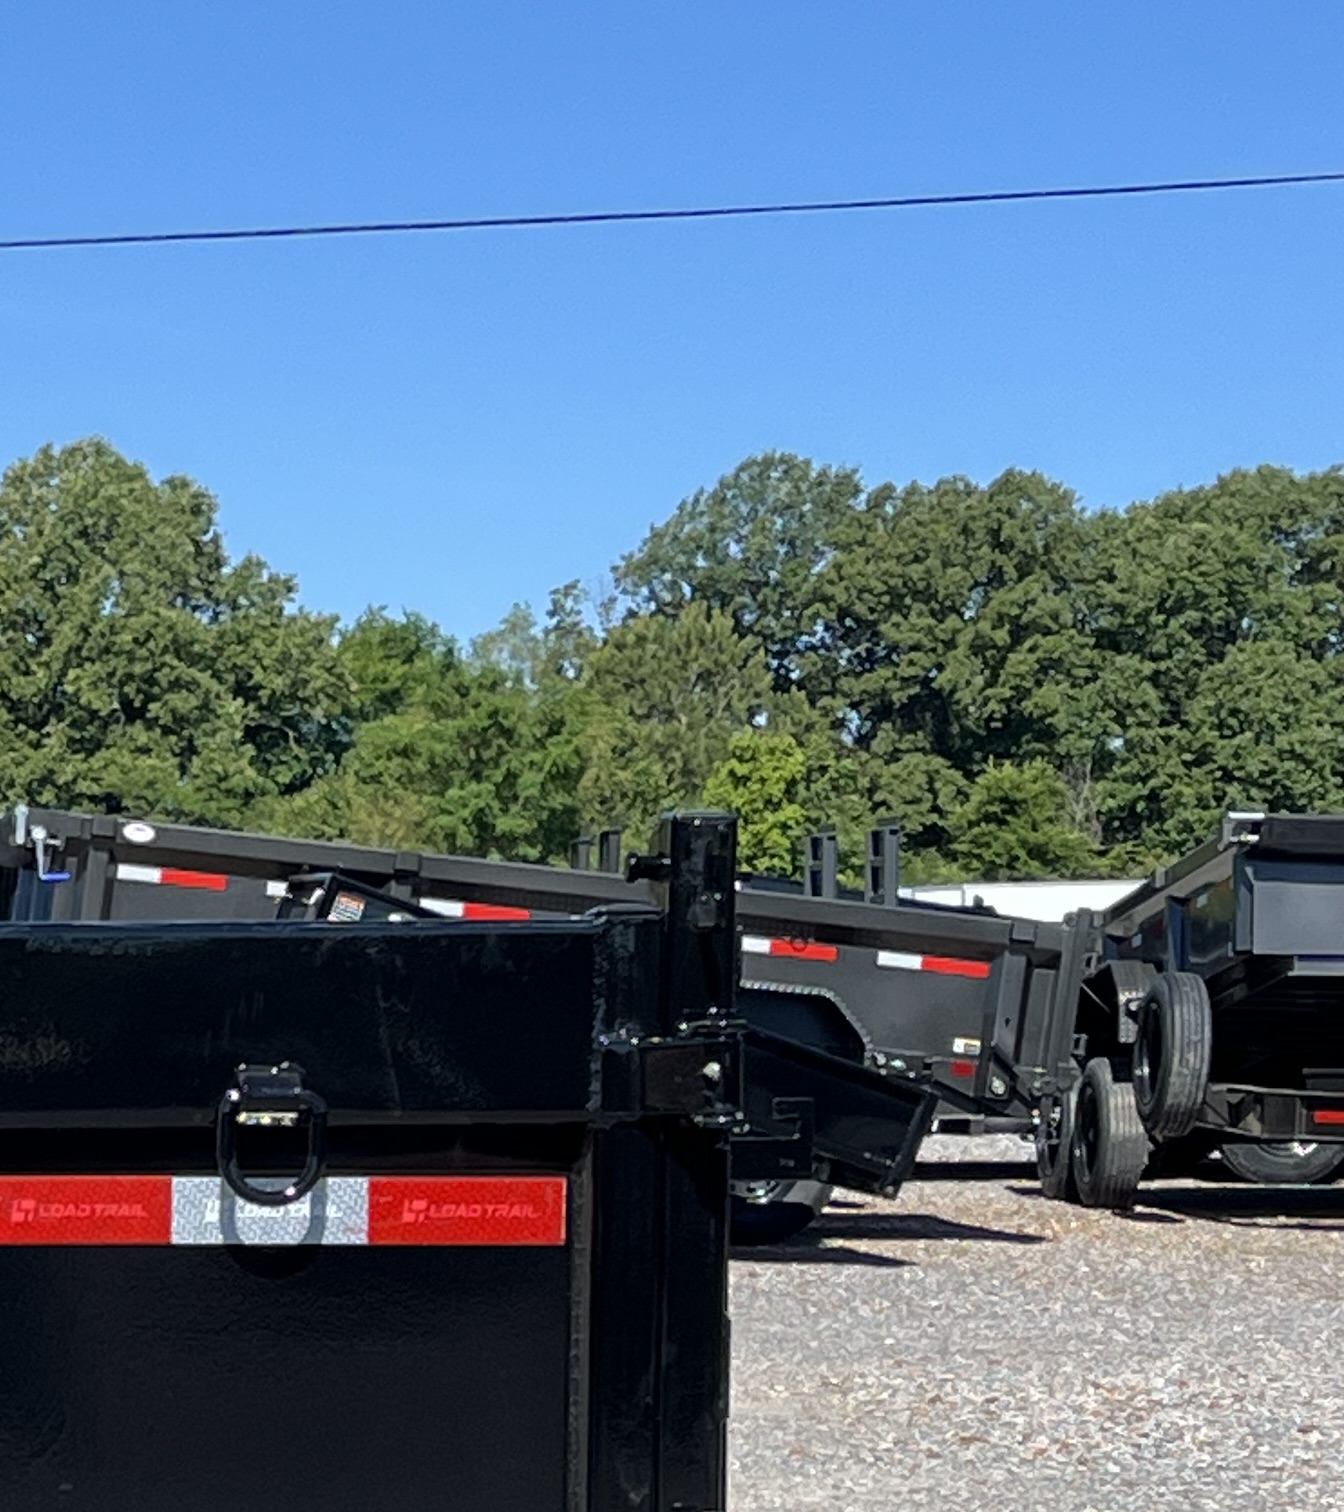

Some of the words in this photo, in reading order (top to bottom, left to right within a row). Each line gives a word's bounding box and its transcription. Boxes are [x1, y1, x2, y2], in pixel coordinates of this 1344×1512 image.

[37, 1203, 91, 1219] LOAD
[93, 1203, 149, 1218] TRAIL
[428, 1203, 482, 1219] LOAD
[484, 1203, 542, 1219] TRAIL
